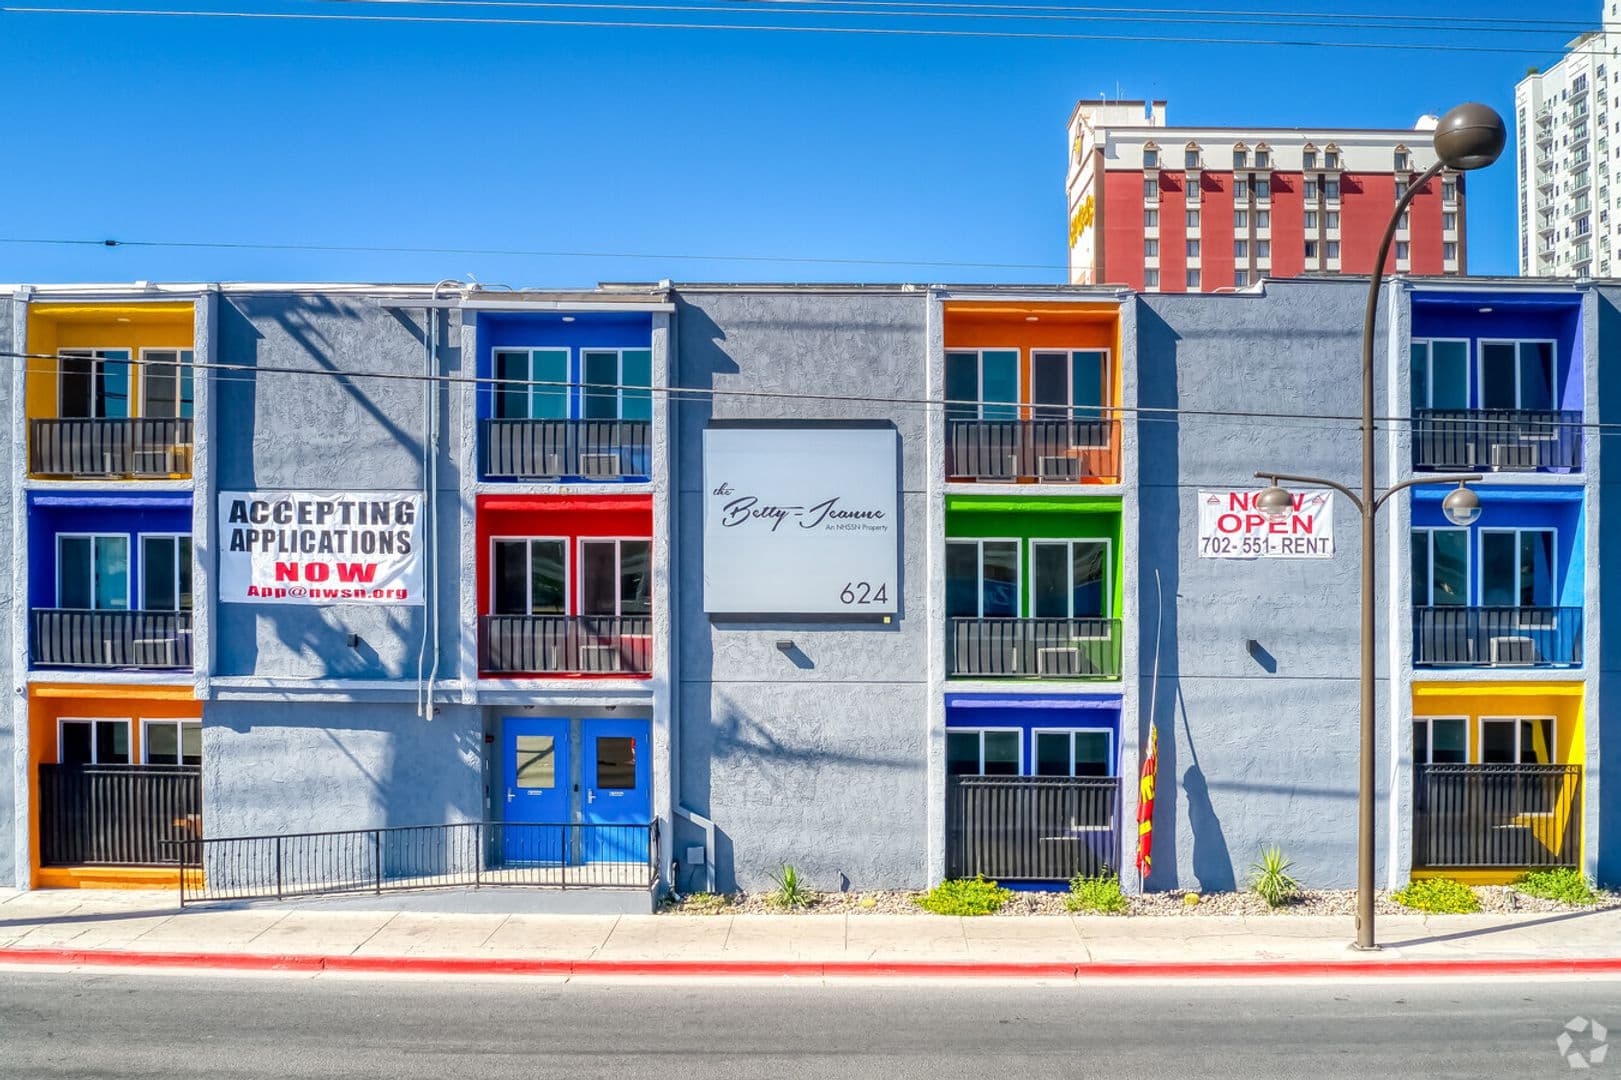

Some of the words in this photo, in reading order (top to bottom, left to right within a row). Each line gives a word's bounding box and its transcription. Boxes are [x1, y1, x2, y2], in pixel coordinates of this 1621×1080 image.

[713, 482, 735, 496] the
[1230, 493, 1305, 511] NW
[229, 500, 415, 525] ACCEPTING
[825, 523, 835, 531] An
[862, 523, 888, 532] Property
[1217, 514, 1313, 534] OPEN
[230, 528, 411, 554] APPLICATIONS
[275, 562, 377, 583] NOW
[247, 585, 408, 600] App@nwsn.org
[840, 582, 888, 604] 624
